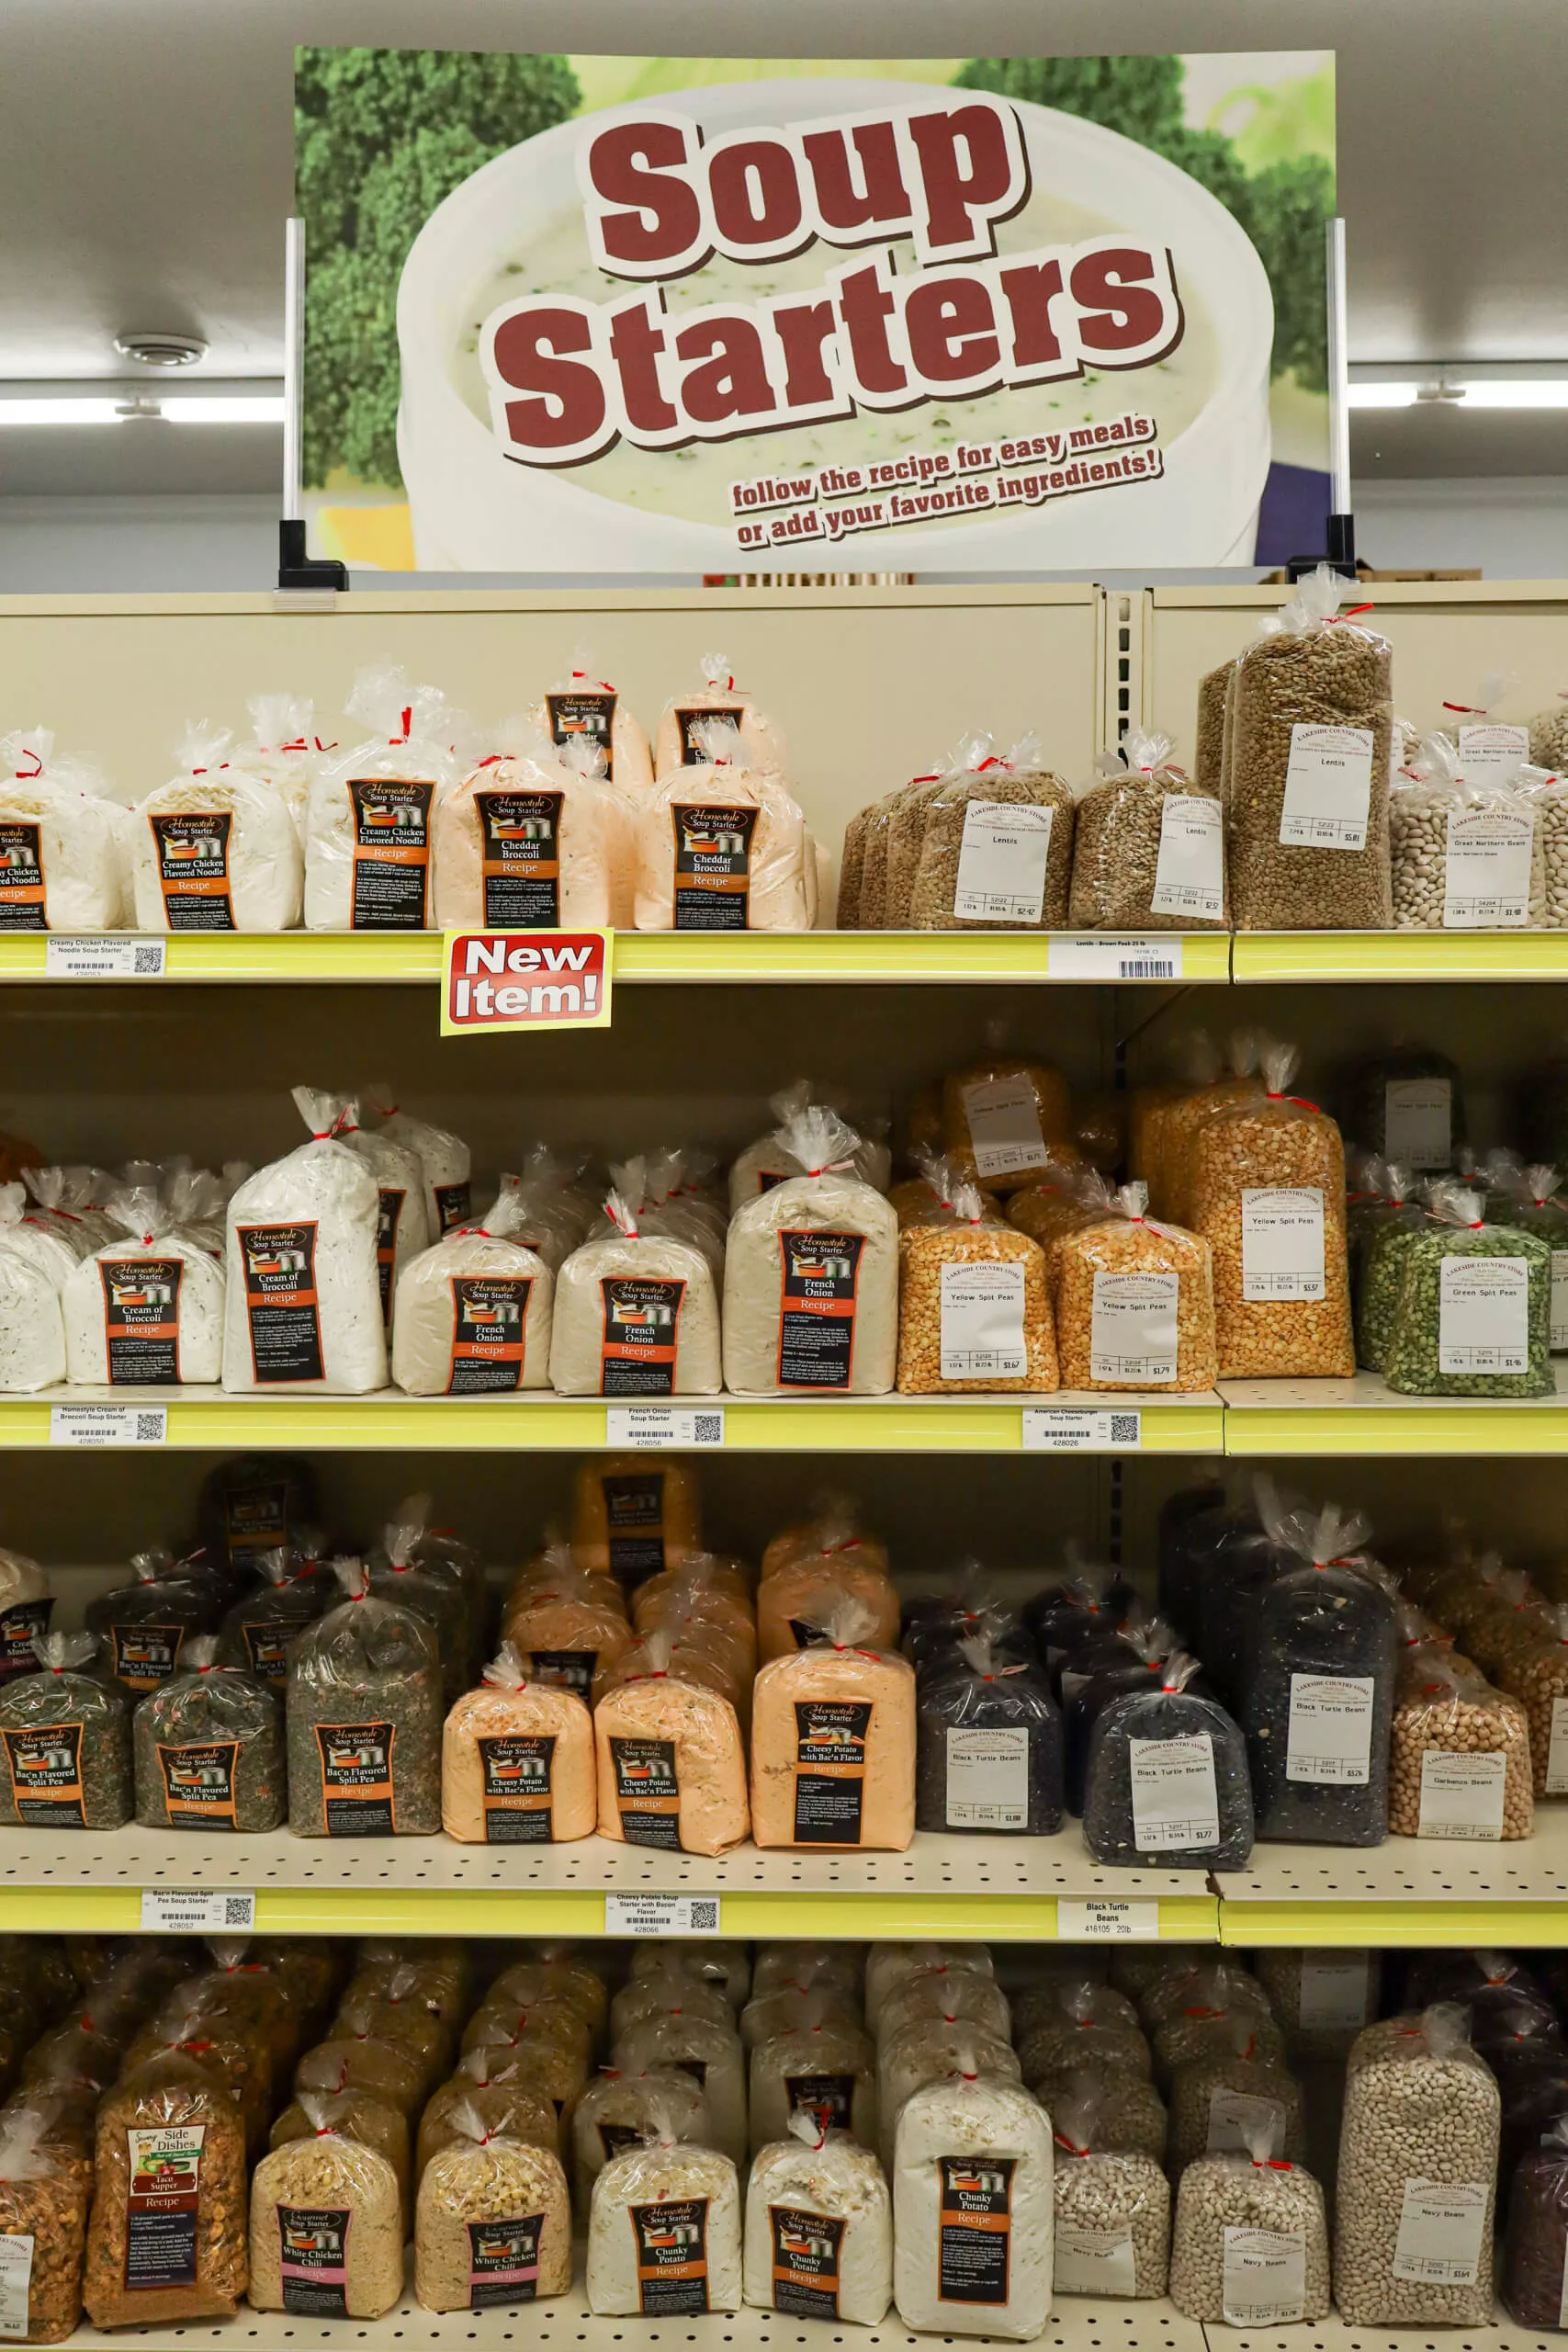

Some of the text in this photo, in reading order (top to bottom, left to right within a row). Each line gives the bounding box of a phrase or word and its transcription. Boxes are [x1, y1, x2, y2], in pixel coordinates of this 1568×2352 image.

[589, 103, 1012, 264] Soup
[492, 248, 1167, 452] Starters
[734, 416, 1150, 507] follow the recipe for easy meals
[739, 449, 1156, 545] or add your favorite ingredients!
[1321, 759, 1345, 767] Lentils
[367, 783, 416, 796] Homestyle
[370, 794, 413, 802] Soup Starter
[360, 828, 389, 837] Creamy
[1186, 828, 1206, 836] Lentils
[360, 836, 423, 845] Flavored Noodle
[502, 841, 539, 849] Cheddar
[993, 836, 1018, 845] Lentils
[375, 849, 408, 858] Recipe
[502, 850, 539, 859] Broccoli
[163, 861, 191, 869] Creamy
[164, 868, 223, 877] Flavored Noodle
[178, 881, 210, 890] Recipe
[465, 940, 593, 975] New
[456, 975, 598, 1018] Item!
[251, 1229, 297, 1242] Homestyle
[259, 1272, 299, 1283] Cream of
[262, 1282, 297, 1291] Broccoli
[805, 1279, 835, 1288] French
[806, 1287, 833, 1297] Onion
[1480, 1289, 1496, 1297] Split
[1500, 1289, 1517, 1297] Peas
[263, 1294, 297, 1304] Recipe
[801, 1300, 835, 1311] Recipe
[1102, 1302, 1126, 1310] Yellow
[1130, 1303, 1145, 1311] Split
[122, 1306, 164, 1315] Cream of
[125, 1314, 161, 1323] Broccoli
[625, 1326, 655, 1335] French
[626, 1335, 653, 1343] Onion
[1320, 1704, 1342, 1713] Turtle
[807, 1746, 832, 1754] Cheesy
[16, 1770, 74, 1779] Bac'n Flavored
[327, 1767, 387, 1776] Bac'n Flavored
[28, 1778, 47, 1787] Split
[339, 1775, 375, 1785] Split Pea
[624, 1779, 648, 1789] Cheesy
[636, 1787, 654, 1795] Bac'n
[633, 1800, 664, 1810] Recipe
[164, 2130, 188, 2140] Side
[157, 2141, 196, 2151] Dishes
[959, 2191, 992, 2203] Chunky
[146, 2197, 180, 2208] Recipe
[962, 2201, 988, 2211] Potato
[1422, 2209, 1441, 2217] Navy
[958, 2212, 990, 2225] Recipe
[283, 2246, 343, 2259] White Chicken
[656, 2247, 688, 2256] Chunky
[301, 2258, 322, 2267] Chili
[659, 2256, 685, 2264] Potato
[1243, 2257, 1262, 2267] Navy
